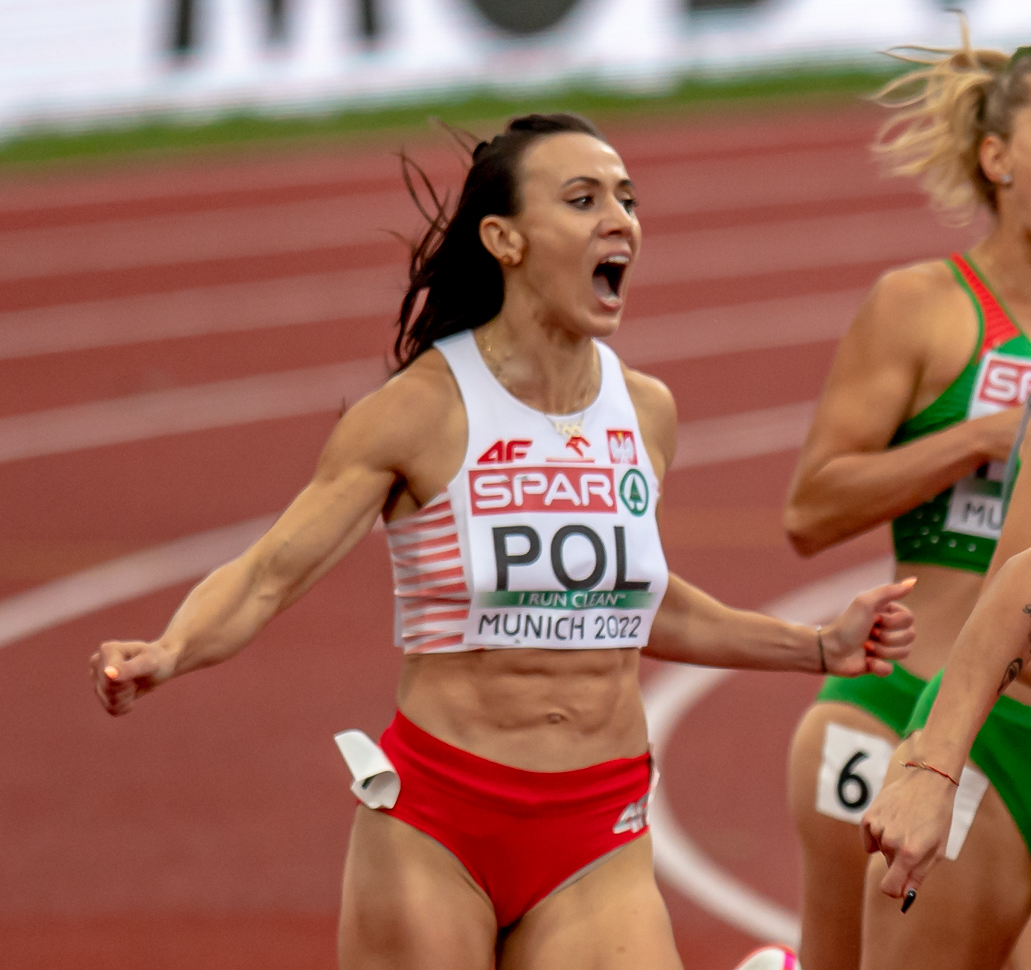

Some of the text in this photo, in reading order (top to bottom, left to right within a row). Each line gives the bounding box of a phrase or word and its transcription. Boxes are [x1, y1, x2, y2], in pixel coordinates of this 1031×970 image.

[477, 439, 533, 464] 4F
[473, 472, 614, 510] SPAR
[492, 524, 652, 592] POL
[529, 594, 567, 606] RUN
[477, 613, 642, 641] MUNICH 2022
[836, 751, 871, 809] 6
